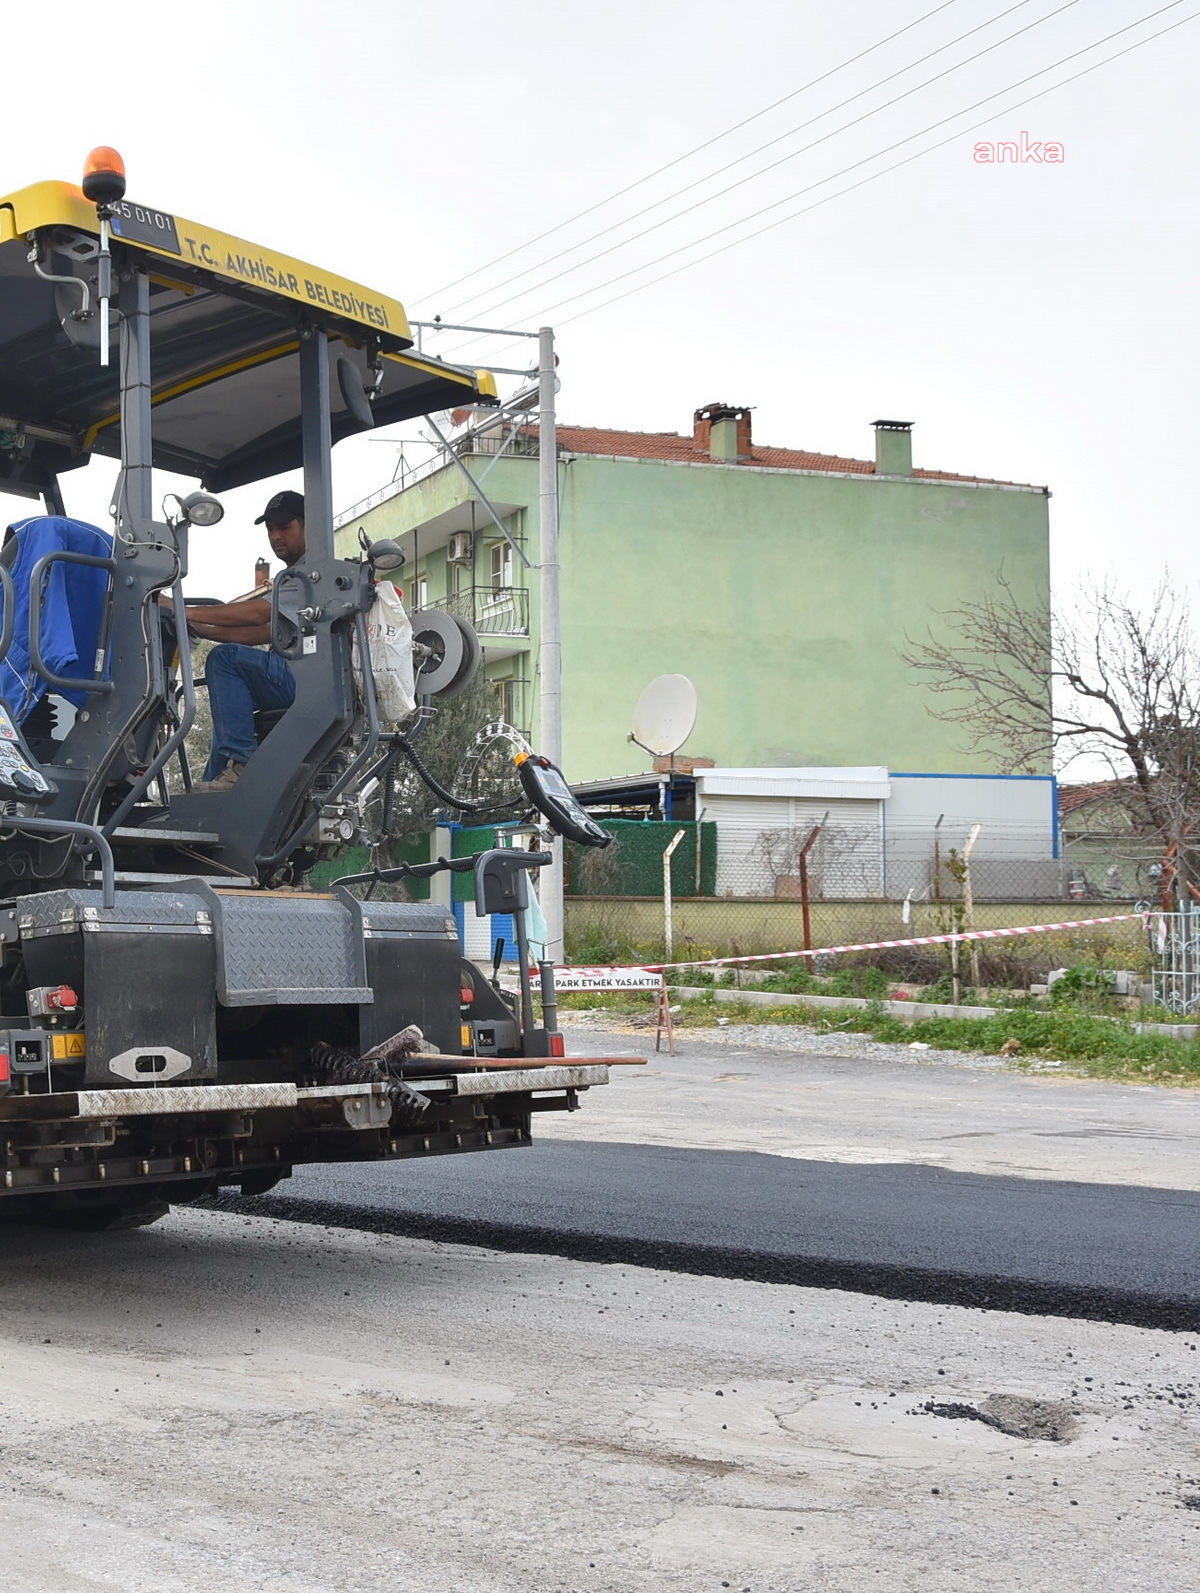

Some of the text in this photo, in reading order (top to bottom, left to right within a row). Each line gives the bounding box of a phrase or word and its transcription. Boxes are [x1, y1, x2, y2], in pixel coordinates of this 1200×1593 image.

[184, 237, 390, 328] T.C. AKHİSAR BELEDİYESİ
[555, 979, 579, 987] PARK
[581, 978, 613, 987] ETMEK
[615, 978, 660, 987] YASAKTIR
